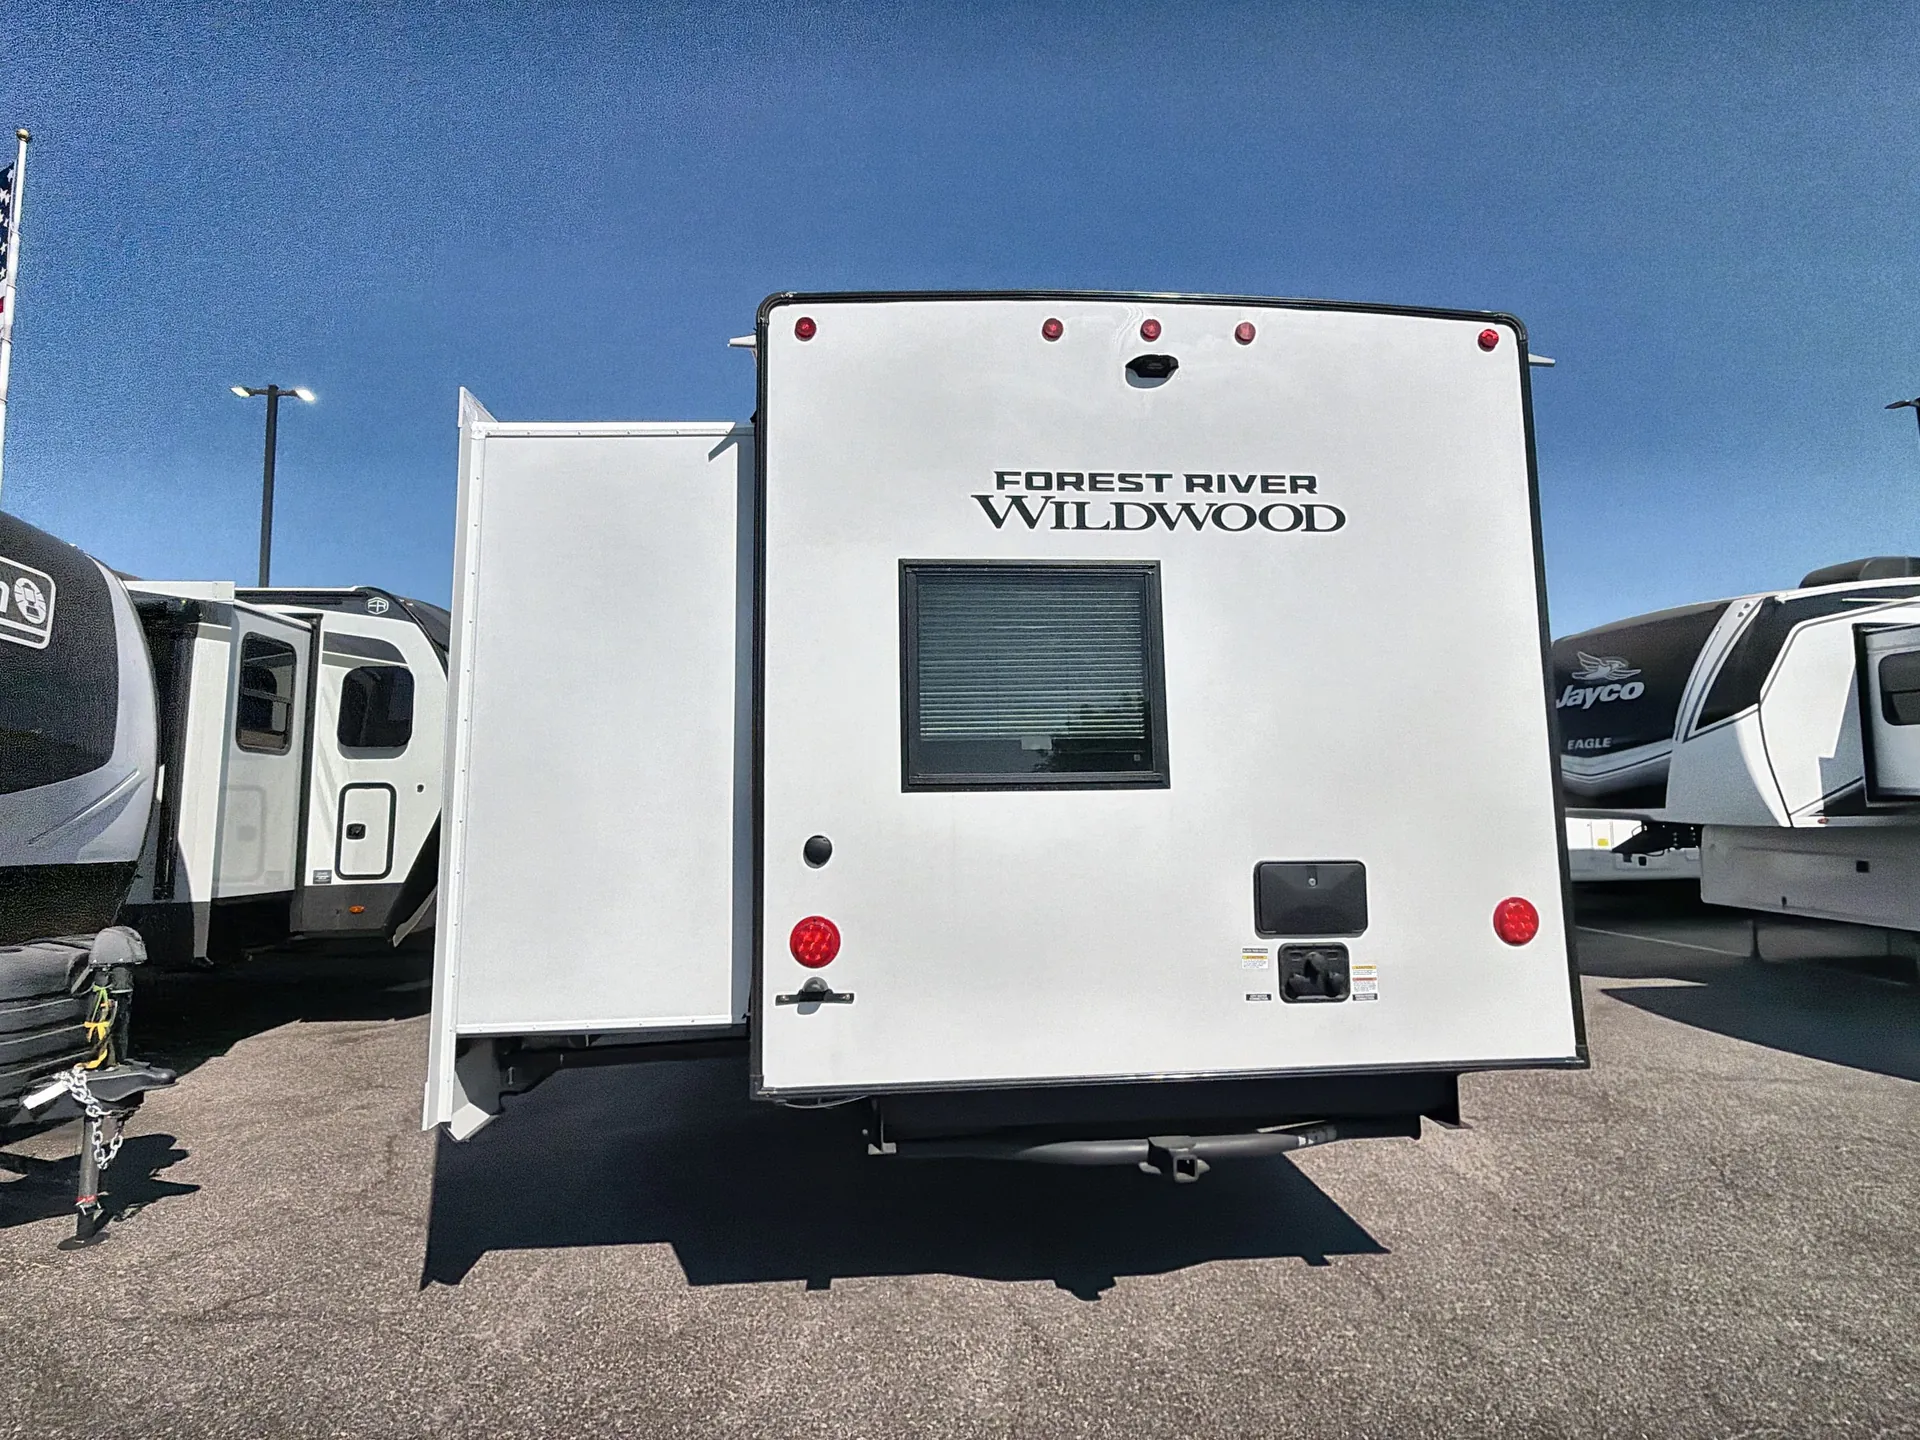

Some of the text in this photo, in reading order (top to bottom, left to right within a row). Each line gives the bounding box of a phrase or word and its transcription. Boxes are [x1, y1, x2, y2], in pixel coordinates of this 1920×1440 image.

[994, 471, 1318, 494] FOREST RIVER
[971, 494, 1347, 533] WILDWOOD
[1555, 681, 1645, 710] Jayco
[1567, 737, 1612, 751] EAGLE
